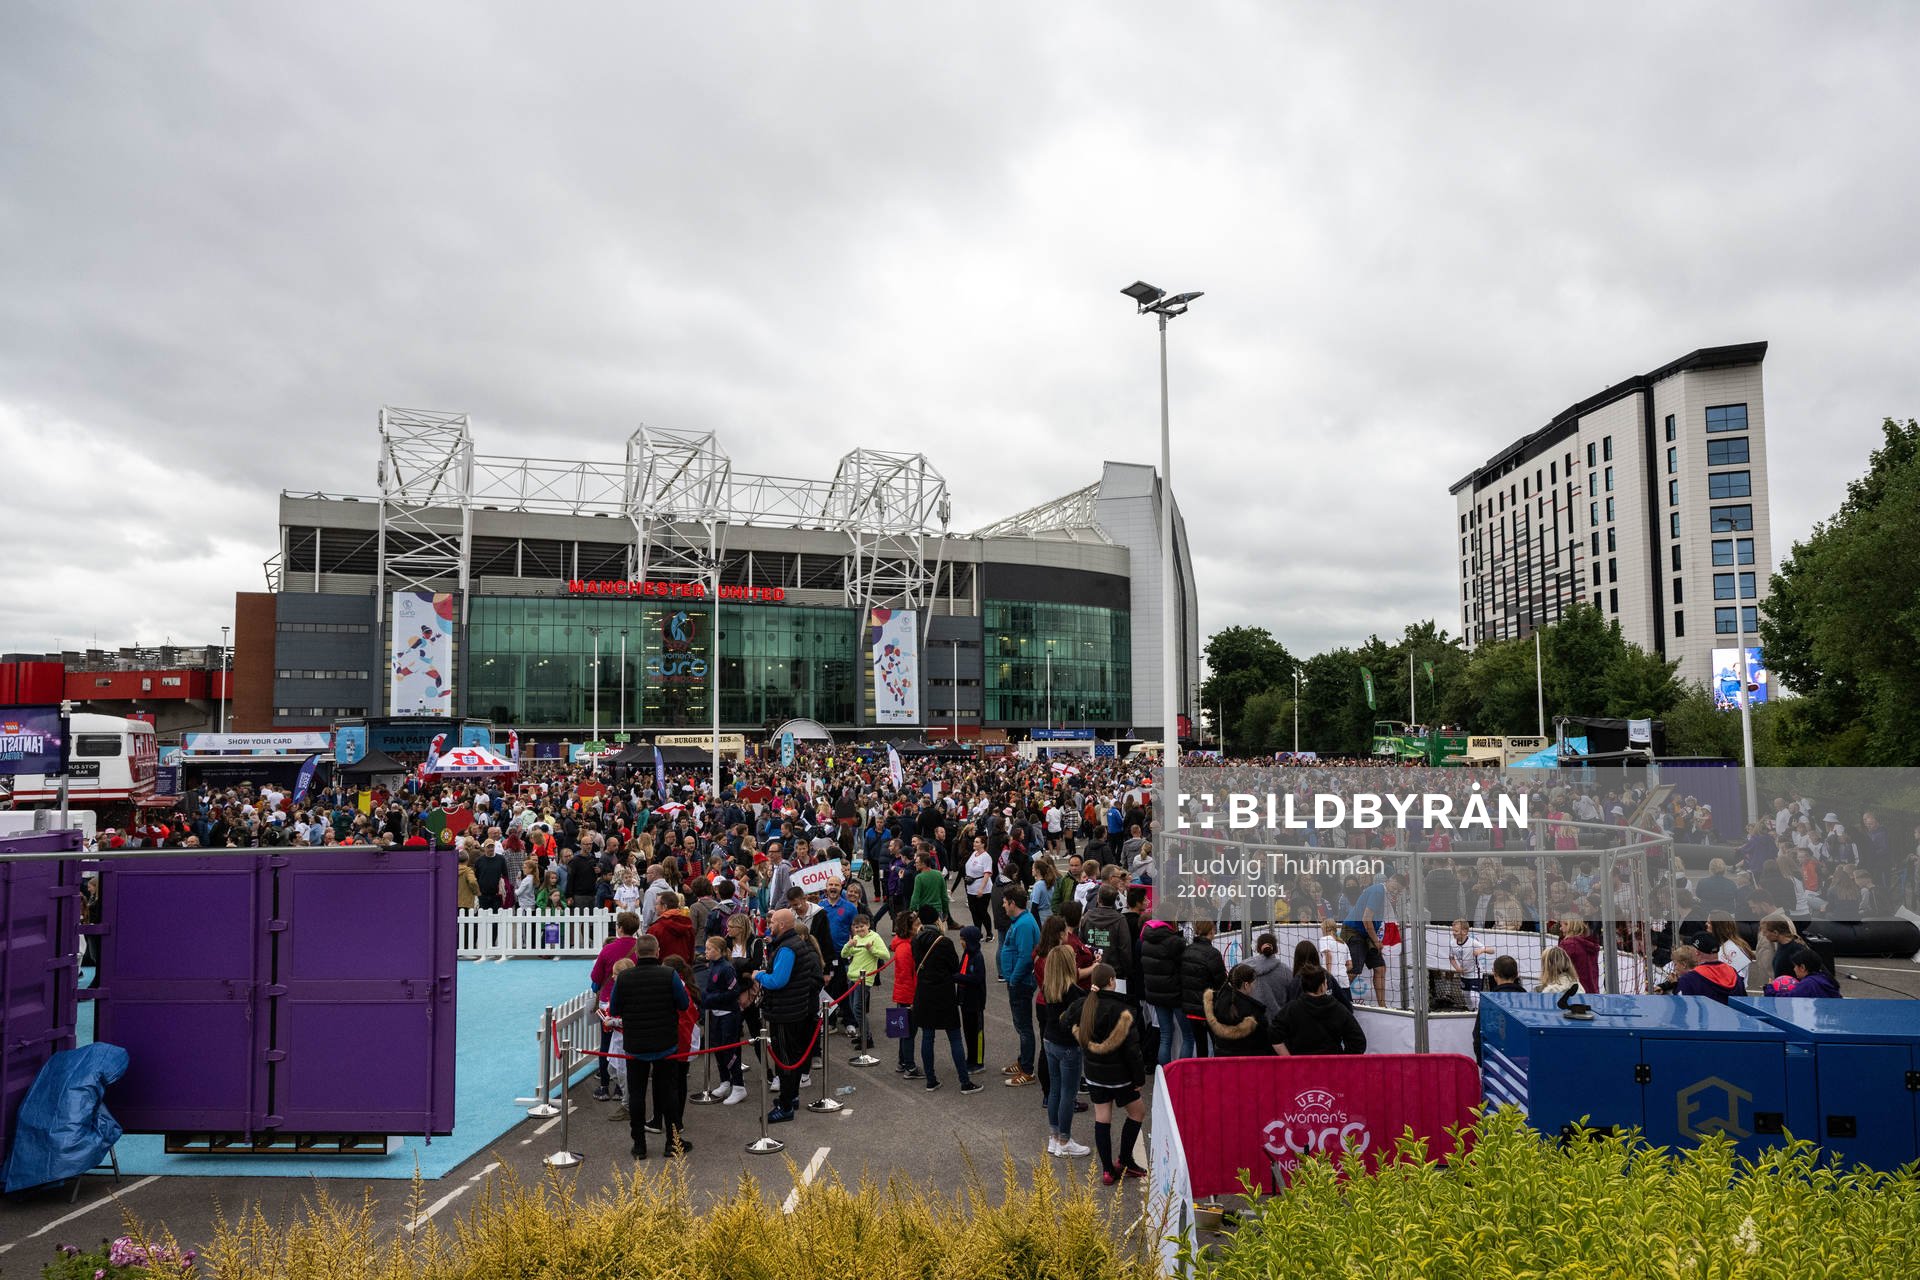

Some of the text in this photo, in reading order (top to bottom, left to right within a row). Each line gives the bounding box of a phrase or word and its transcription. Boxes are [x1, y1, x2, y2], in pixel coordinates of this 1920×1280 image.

[569, 580, 785, 600] MANCHESTER UNITED
[384, 736, 431, 744] FAN PART
[1511, 739, 1540, 747] CHIPS
[1297, 1094, 1333, 1108] UEFA
[1284, 1110, 1348, 1124] women's
